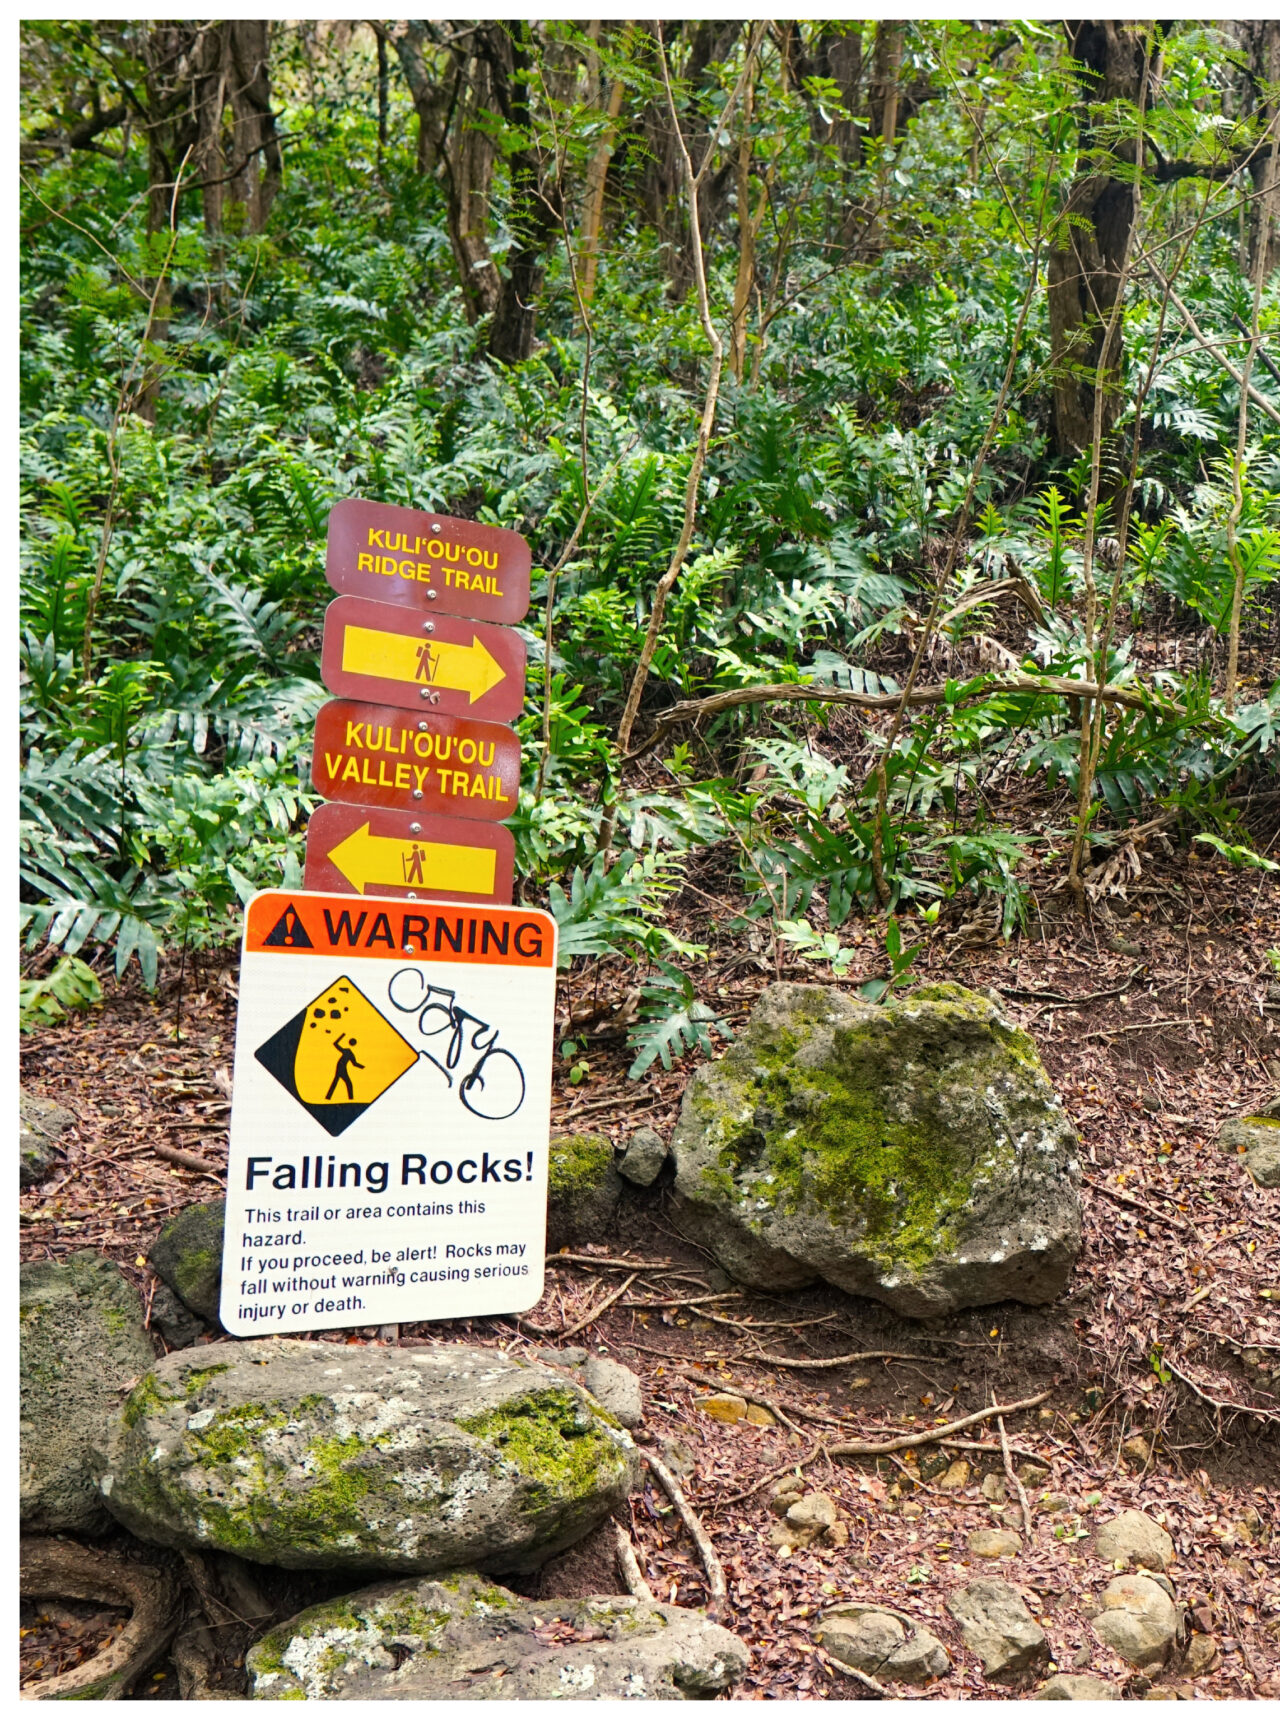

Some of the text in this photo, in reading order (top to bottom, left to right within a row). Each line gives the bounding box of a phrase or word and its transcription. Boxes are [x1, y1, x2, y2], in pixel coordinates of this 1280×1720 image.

[357, 552, 504, 597] RIDGE TRAIL
[345, 721, 496, 767] KULI'OU'OU
[325, 752, 509, 802] VALLEY TRAIL
[323, 908, 543, 958] WARNING
[245, 1151, 533, 1194] Falling Rocks!
[244, 1200, 486, 1224] This trail or area contains this
[242, 1230, 307, 1248] hazard.
[241, 1243, 527, 1274] If you proceed, be alert! Rocks may
[240, 1263, 529, 1296] fall without warning causing serious
[238, 1295, 366, 1322] injury or death.
